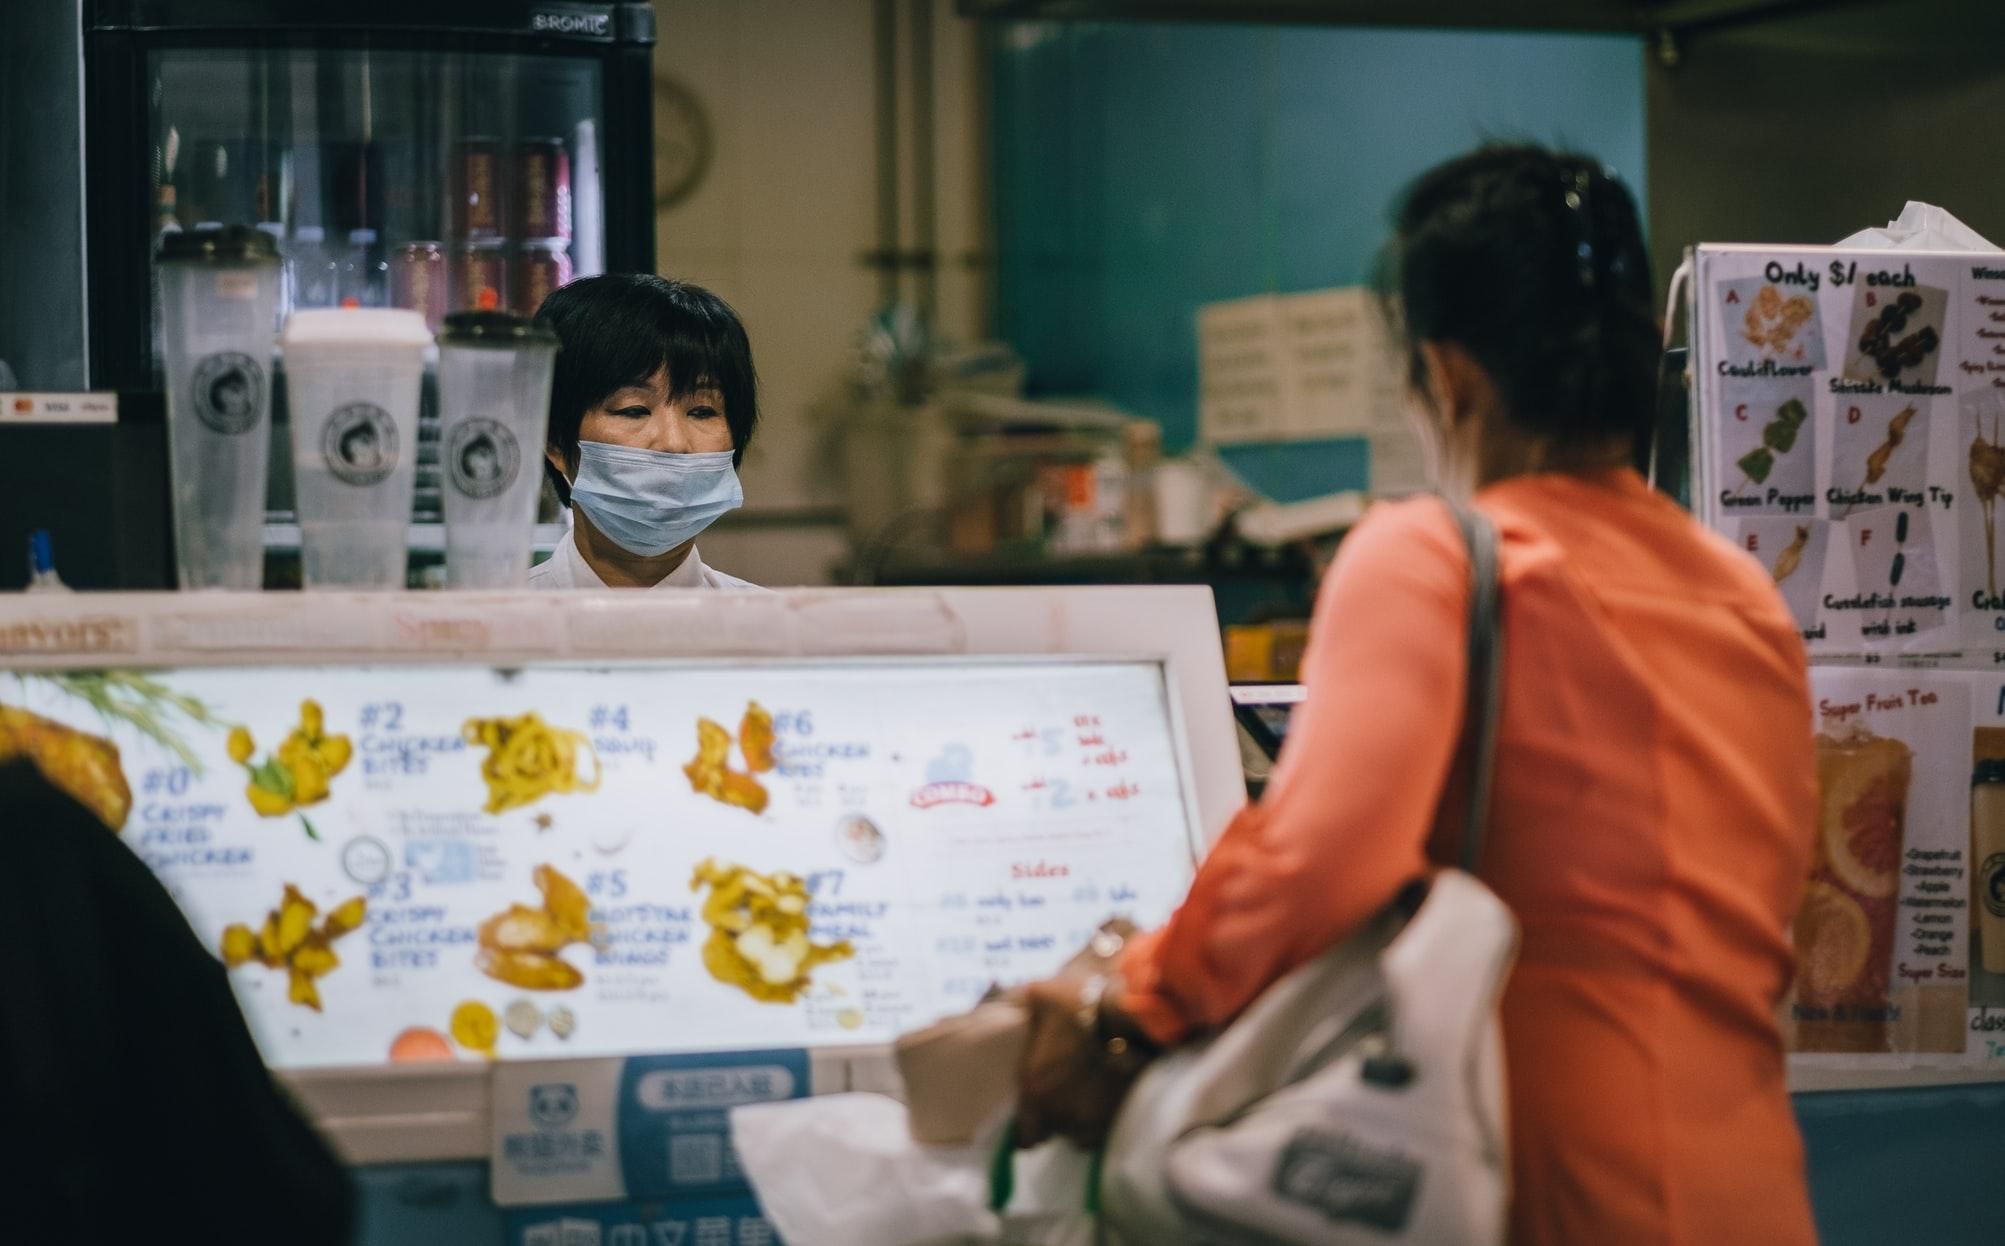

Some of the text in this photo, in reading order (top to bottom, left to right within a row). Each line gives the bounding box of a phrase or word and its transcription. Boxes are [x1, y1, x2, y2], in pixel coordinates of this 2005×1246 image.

[533, 14, 609, 35] BROMIC
[1765, 261, 1820, 291] Only
[1866, 263, 1916, 287] each
[1725, 289, 1740, 304] A
[1865, 291, 1877, 307] B
[1717, 358, 1814, 377] Cauliflower
[1735, 404, 1748, 421] C
[1848, 406, 1861, 424] D
[1720, 488, 1816, 512] Green Pepper
[1826, 486, 1953, 509] Chicken Wing Tip
[1746, 534, 1759, 551] E
[1860, 529, 1873, 546] F
[1820, 689, 1938, 721] Super Fruit Tea
[360, 703, 404, 731] #2
[589, 704, 630, 732] #4
[774, 711, 814, 736] #6
[361, 737, 466, 752] CHICKEN
[141, 803, 226, 822] CRISPY
[1011, 860, 1071, 880] Sides
[586, 870, 627, 897] #5
[806, 870, 845, 896] #7
[369, 928, 476, 945] CHICKEN
[1898, 962, 1966, 983] Super Size
